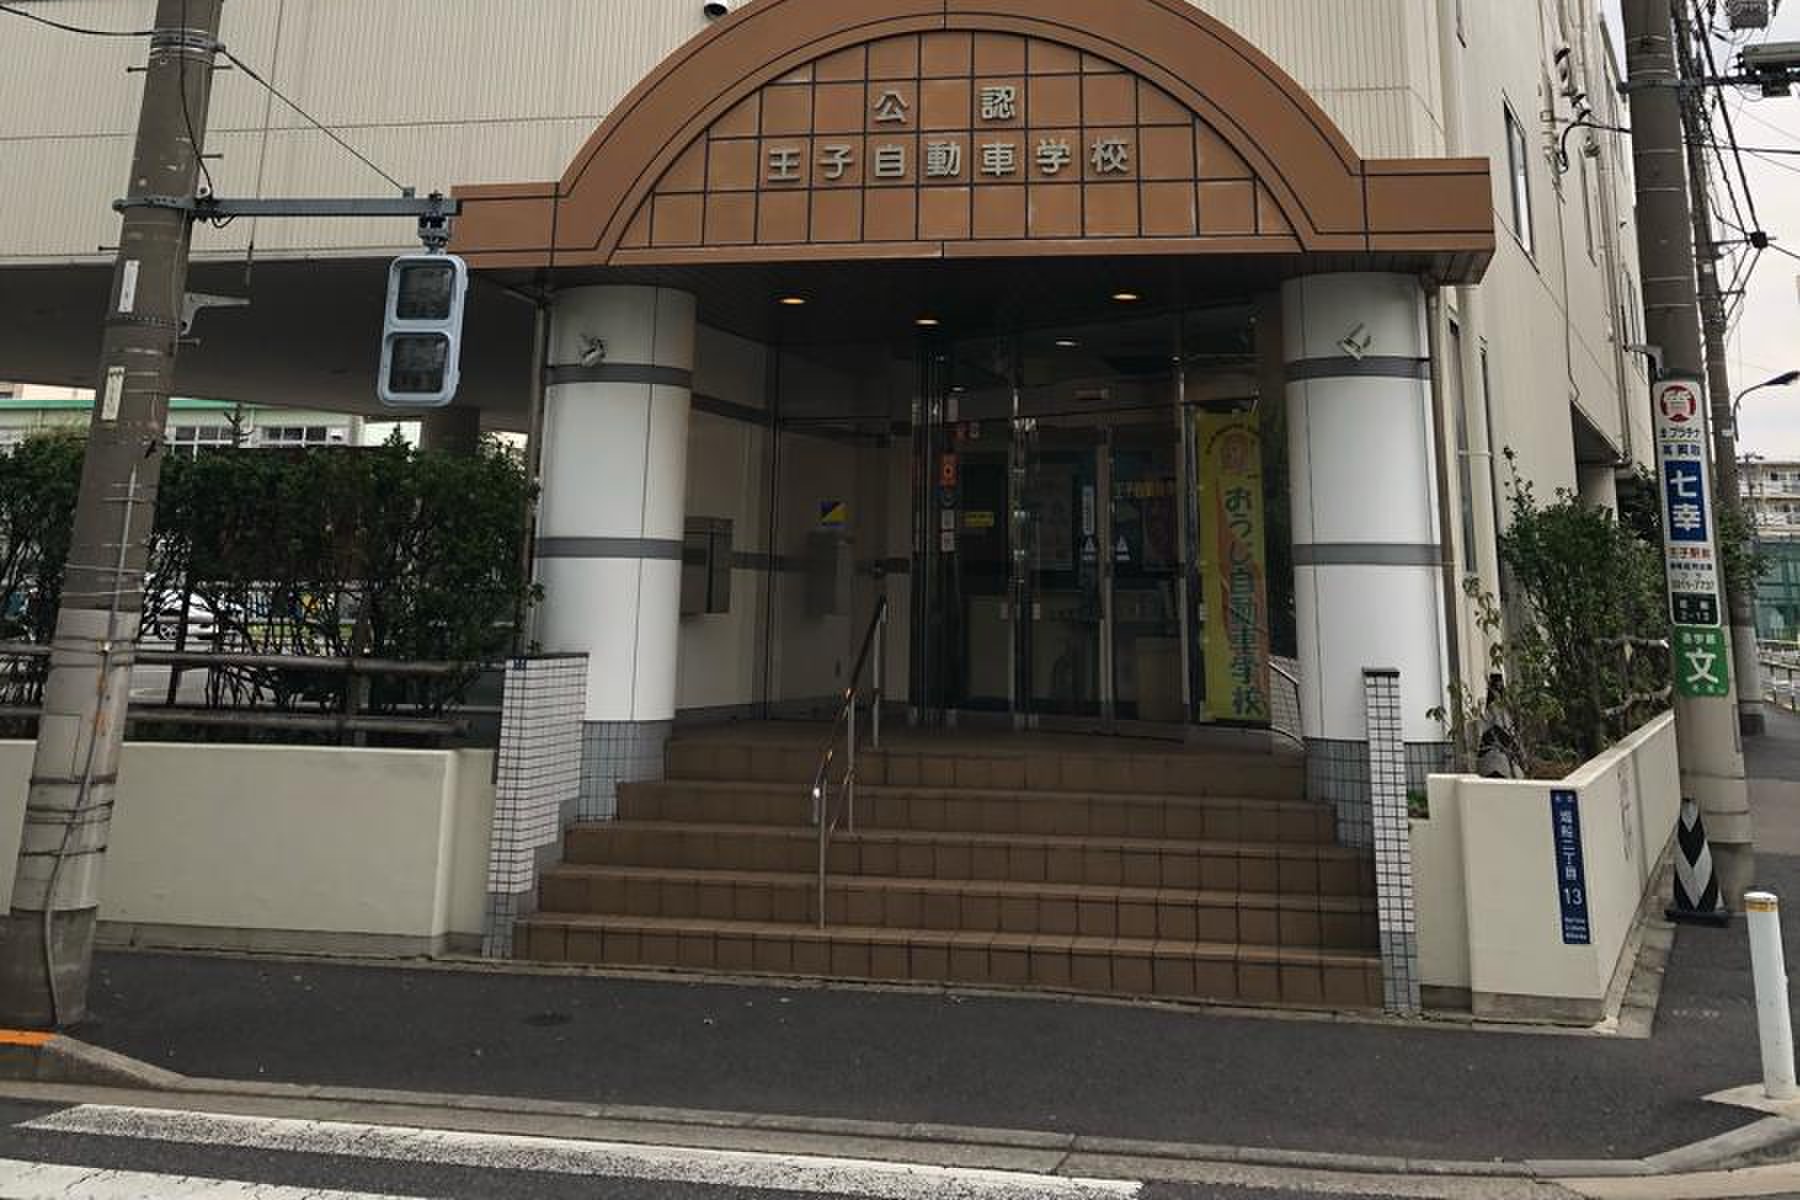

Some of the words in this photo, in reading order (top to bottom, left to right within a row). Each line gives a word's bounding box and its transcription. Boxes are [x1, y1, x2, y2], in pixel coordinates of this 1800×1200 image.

[873, 86, 1016, 123] 公認
[767, 137, 1130, 182] 王子自動車学校
[1669, 469, 1701, 531] 七幸
[1684, 647, 1719, 684] 文
[1563, 887, 1583, 905] 13
